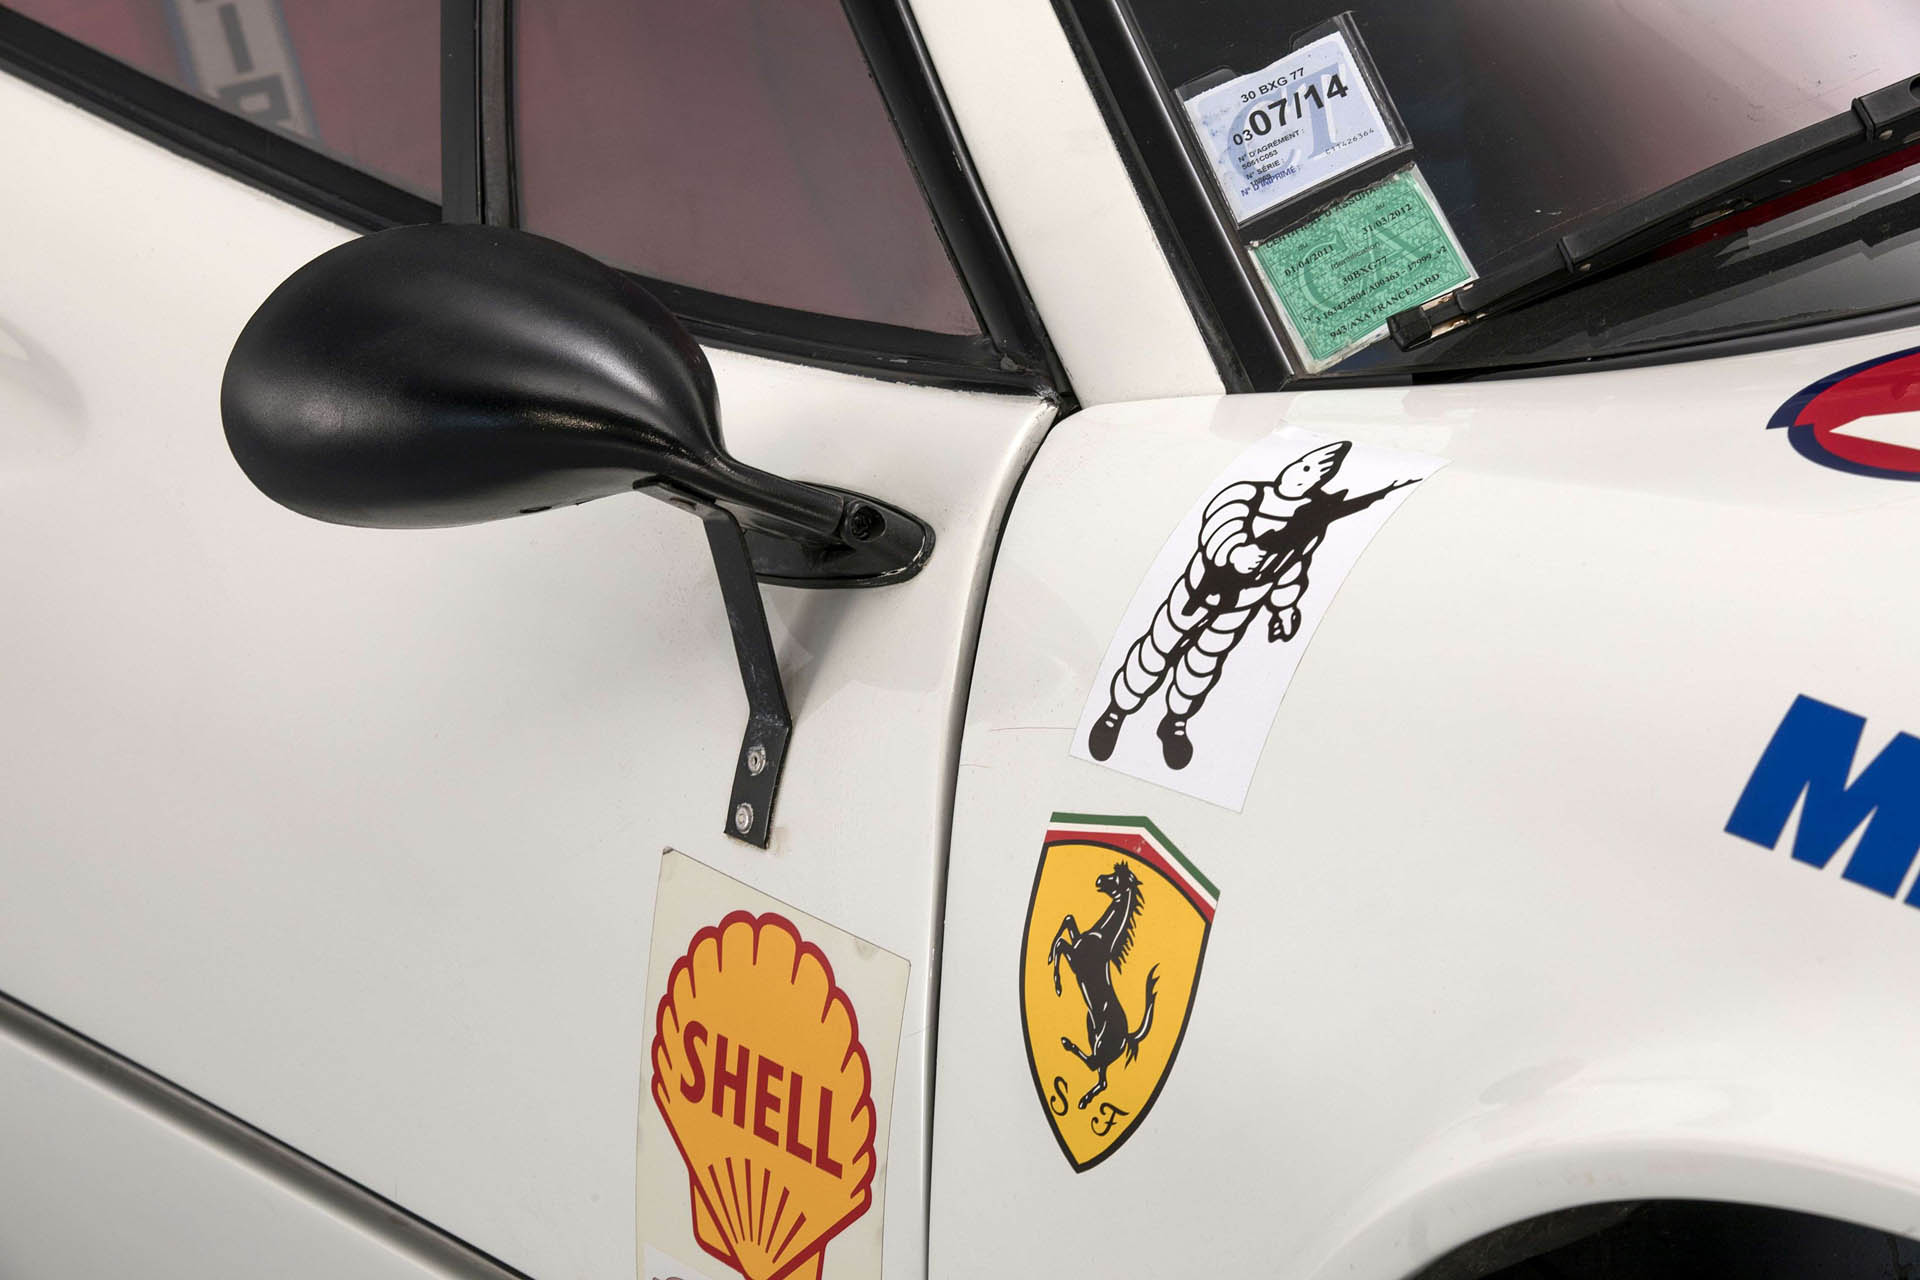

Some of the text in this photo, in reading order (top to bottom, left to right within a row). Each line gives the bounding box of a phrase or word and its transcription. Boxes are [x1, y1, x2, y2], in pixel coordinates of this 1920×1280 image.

[1241, 67, 1305, 103] 30 BXG 77
[1724, 693, 1920, 911] M
[680, 1020, 843, 1180] SHELL
